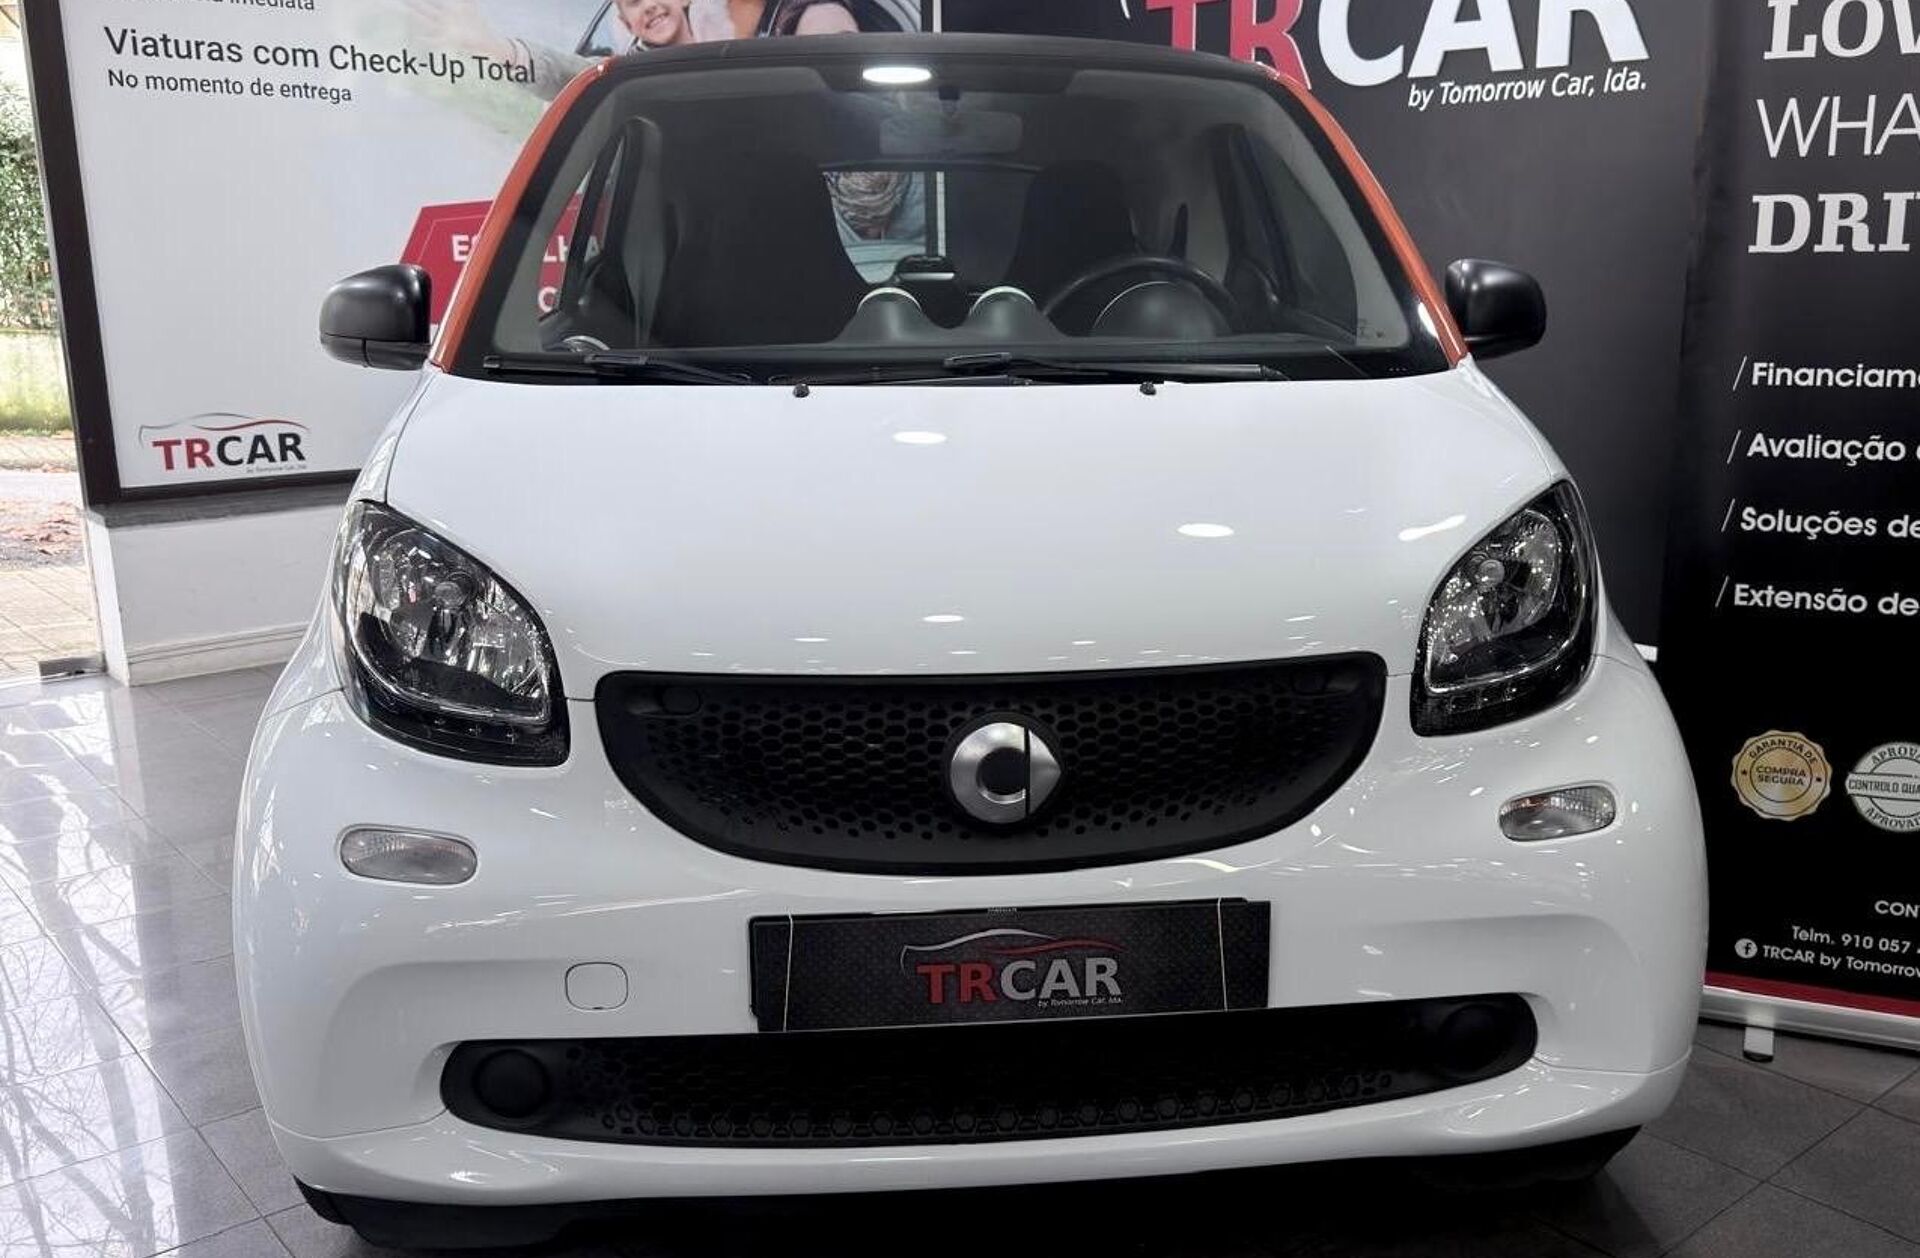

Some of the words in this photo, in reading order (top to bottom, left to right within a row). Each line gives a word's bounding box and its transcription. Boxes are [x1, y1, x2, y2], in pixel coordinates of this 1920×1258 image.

[104, 26, 243, 63] Viaturas
[253, 44, 319, 68] com
[329, 45, 465, 84] Check-Up
[472, 56, 535, 83] Total
[108, 69, 138, 88] No
[145, 74, 244, 95] momento
[250, 77, 274, 97] de
[280, 83, 352, 104] entrega
[1408, 84, 1434, 111] by
[1439, 78, 1546, 105] Tomorrow
[1552, 72, 1595, 97] Car,
[1603, 66, 1648, 93] lda.
[1748, 192, 1920, 253] DRI
[1752, 362, 1920, 388] Financiam
[152, 432, 305, 471] TRCAR
[1747, 433, 1906, 466] Avaliação
[1740, 506, 1877, 540] Soluções
[1734, 583, 1868, 613] Extensão
[1877, 592, 1920, 616] de
[1749, 738, 1804, 759] GARANTIA
[1756, 765, 1806, 777] COMPRA
[1758, 774, 1804, 786] SEGURA
[1848, 779, 1899, 793] CONTROLO
[1874, 900, 1920, 918] CON
[1791, 925, 1835, 945] Telm.
[1842, 933, 1873, 950] 910
[1879, 937, 1911, 954] 057
[1763, 945, 1815, 964] TRCAR
[1820, 952, 1842, 970] by
[916, 957, 1122, 1004] TRCAR
